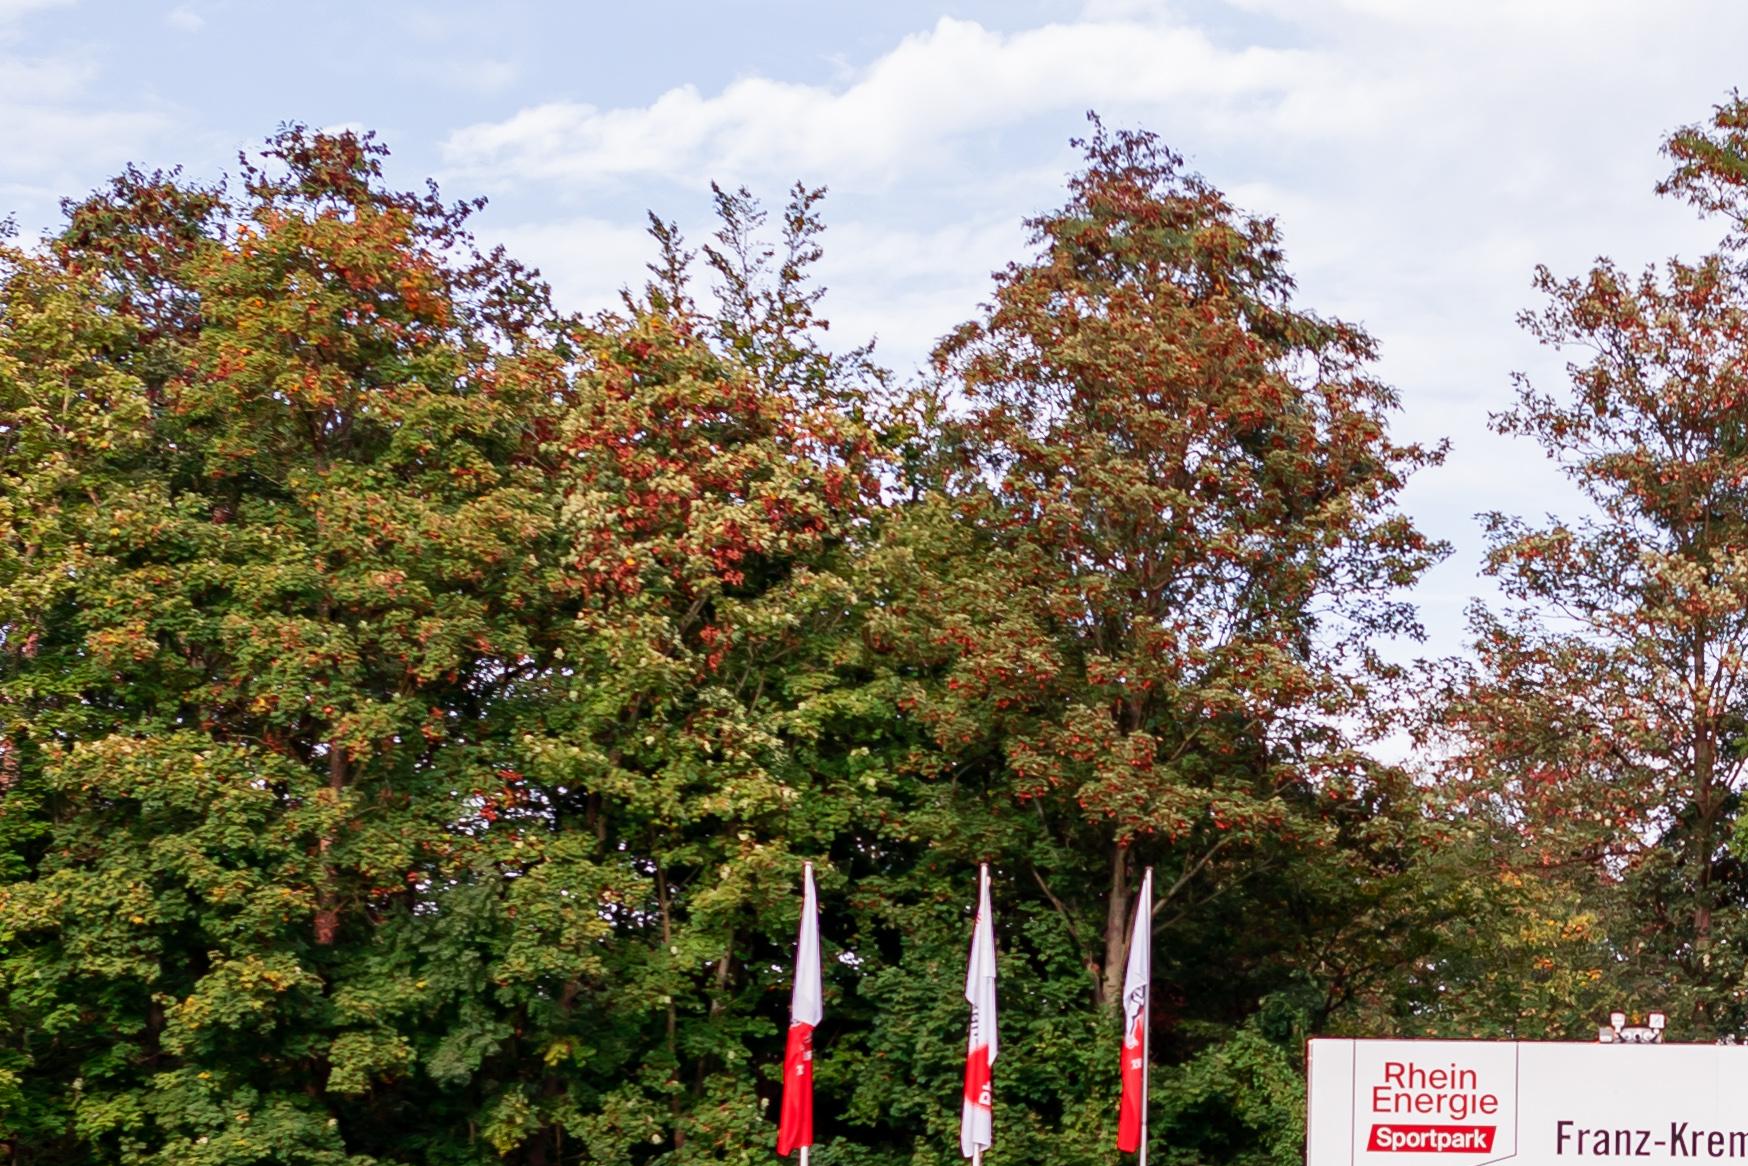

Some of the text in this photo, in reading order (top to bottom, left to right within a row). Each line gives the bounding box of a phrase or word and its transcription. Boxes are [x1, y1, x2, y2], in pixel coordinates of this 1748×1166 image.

[1384, 1062, 1477, 1090] Rhein
[1372, 1086, 1499, 1121] Energie
[1376, 1126, 1487, 1152] Sportpark
